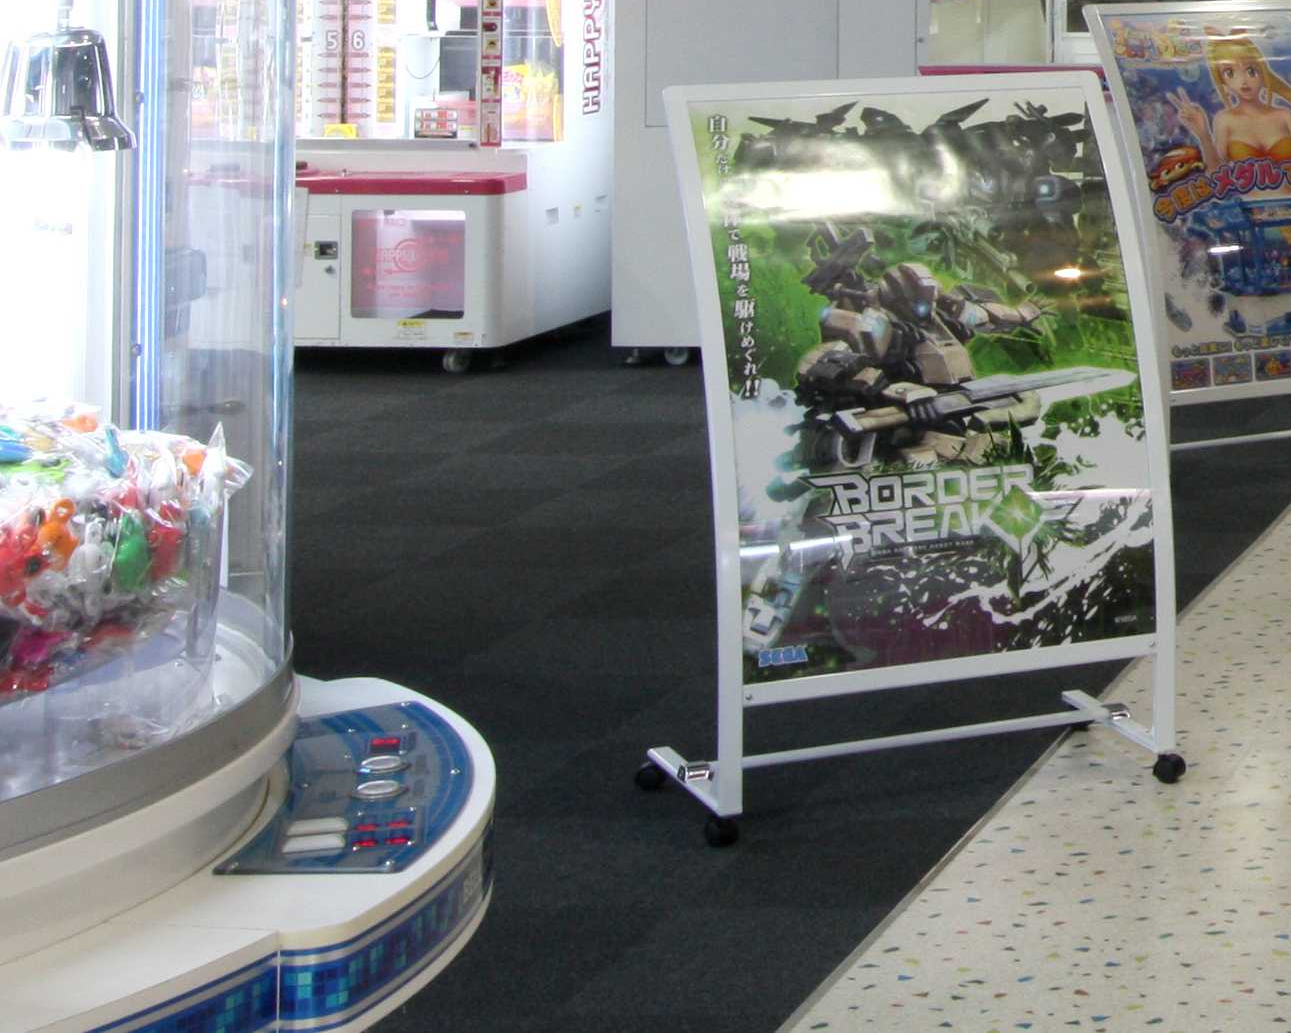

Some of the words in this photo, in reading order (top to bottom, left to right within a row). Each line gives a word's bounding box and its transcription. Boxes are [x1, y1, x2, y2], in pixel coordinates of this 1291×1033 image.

[352, 30, 366, 51] 6
[809, 463, 1034, 516] BORDER
[818, 500, 1012, 559] BREAK
[758, 645, 809, 668] SEGA
